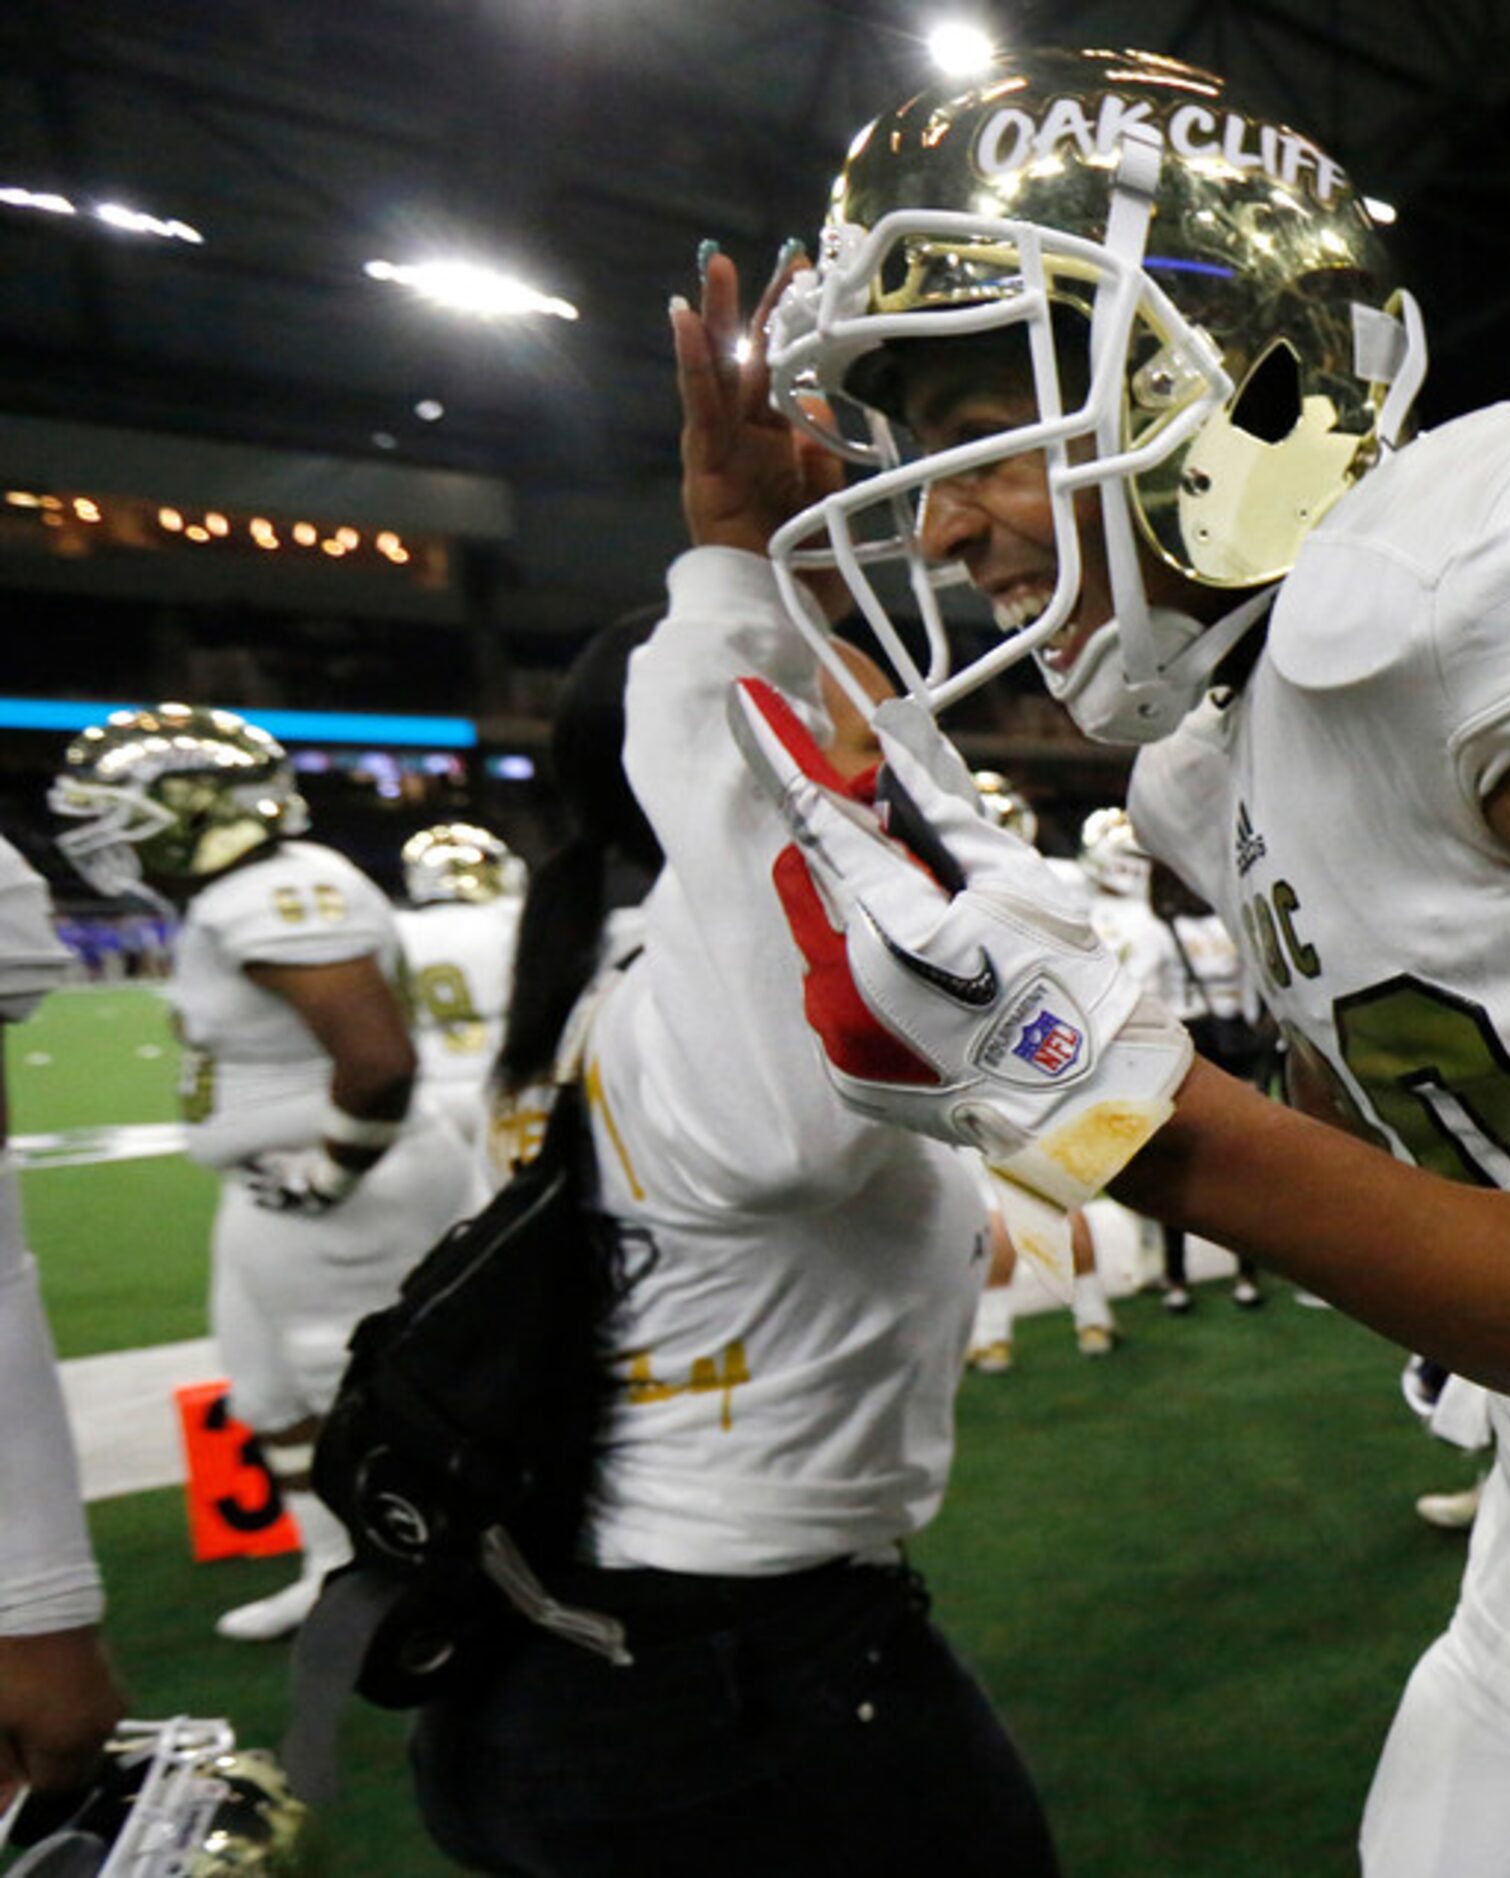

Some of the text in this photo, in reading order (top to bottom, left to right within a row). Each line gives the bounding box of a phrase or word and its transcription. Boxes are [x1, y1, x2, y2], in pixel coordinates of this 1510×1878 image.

[978, 96, 1346, 201] OAK CLIFF
[1033, 1024, 1078, 1071] NFL
[203, 1394, 286, 1534] 3
